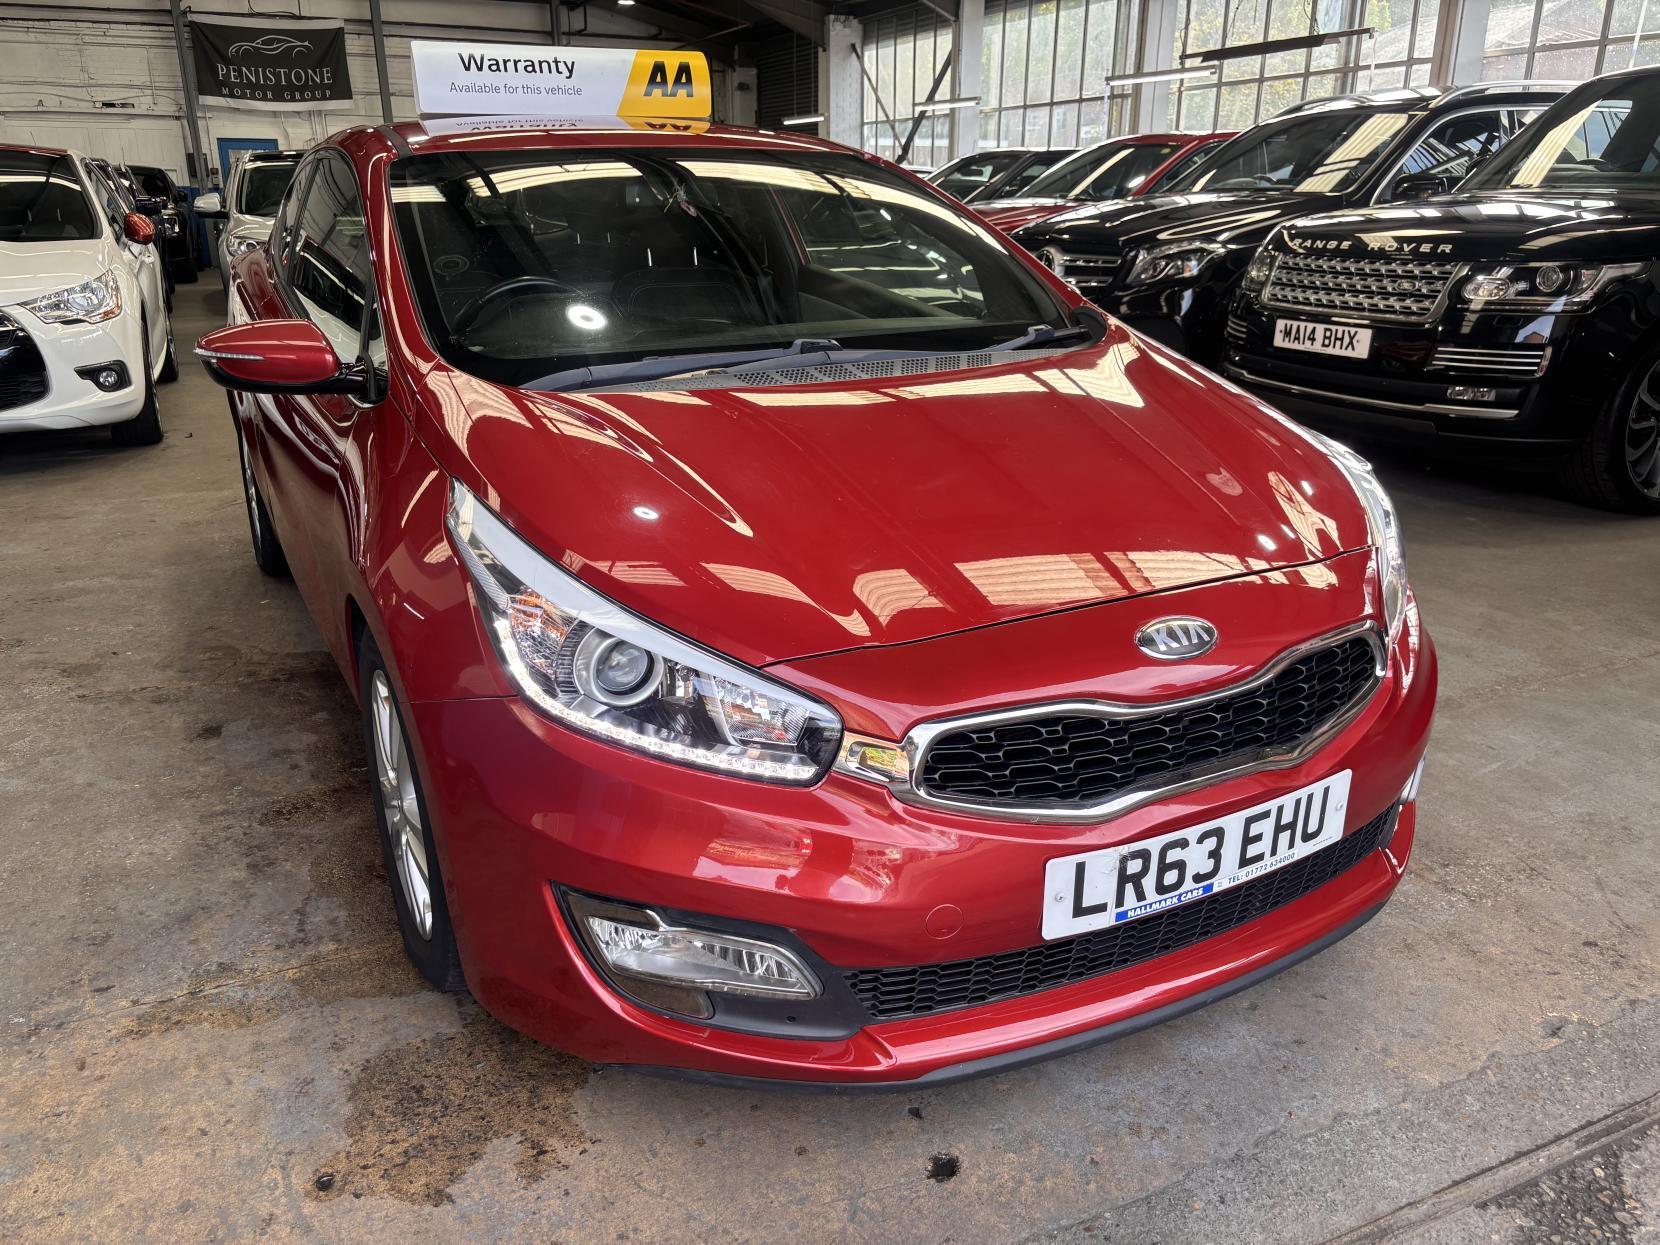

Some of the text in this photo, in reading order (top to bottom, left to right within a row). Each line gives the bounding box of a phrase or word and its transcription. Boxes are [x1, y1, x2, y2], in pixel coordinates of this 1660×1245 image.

[217, 63, 333, 86] PENISTONE
[457, 52, 576, 80] Warranty
[643, 60, 694, 97] AA
[222, 87, 331, 100] MOTOR GROUP
[449, 81, 583, 96] Available for this vehicle
[1291, 238, 1453, 253] RANGE ROVER
[1282, 323, 1358, 351] MA14 BHX
[1149, 623, 1210, 651] KIA
[1072, 785, 1331, 919] LR63 EHU
[1127, 896, 1179, 918] HALLMARK
[1180, 887, 1204, 902] CARS
[1228, 874, 1244, 885] TEL:
[1245, 863, 1268, 878] 01772
